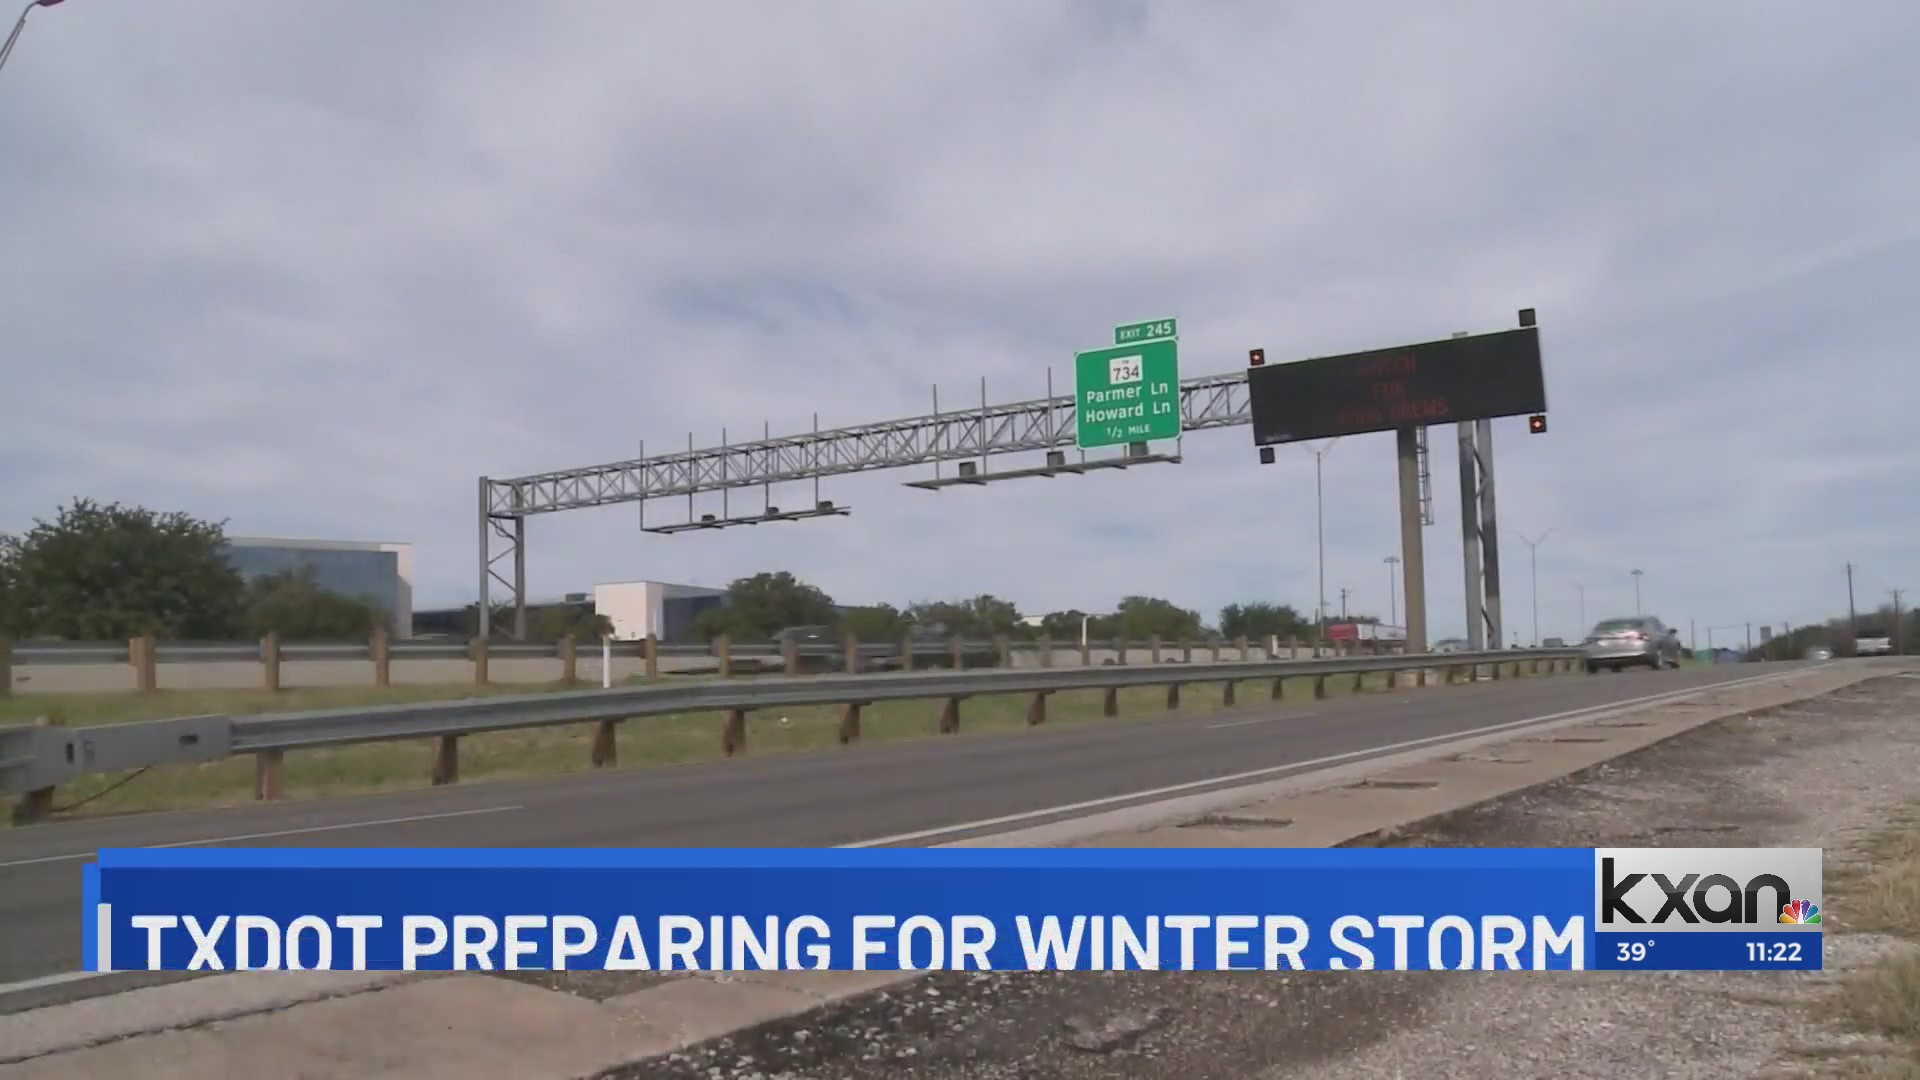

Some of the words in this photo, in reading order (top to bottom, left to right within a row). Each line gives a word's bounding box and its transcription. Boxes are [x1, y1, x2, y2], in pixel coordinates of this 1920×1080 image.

[1119, 328, 1140, 340] EXIT
[1146, 322, 1172, 337] 245
[1112, 365, 1140, 381] 734
[1087, 386, 1142, 404] Parmer
[1151, 382, 1168, 395] Ln
[1086, 403, 1144, 423] Howard
[1153, 402, 1171, 415] Ln
[1128, 424, 1150, 434] MILE
